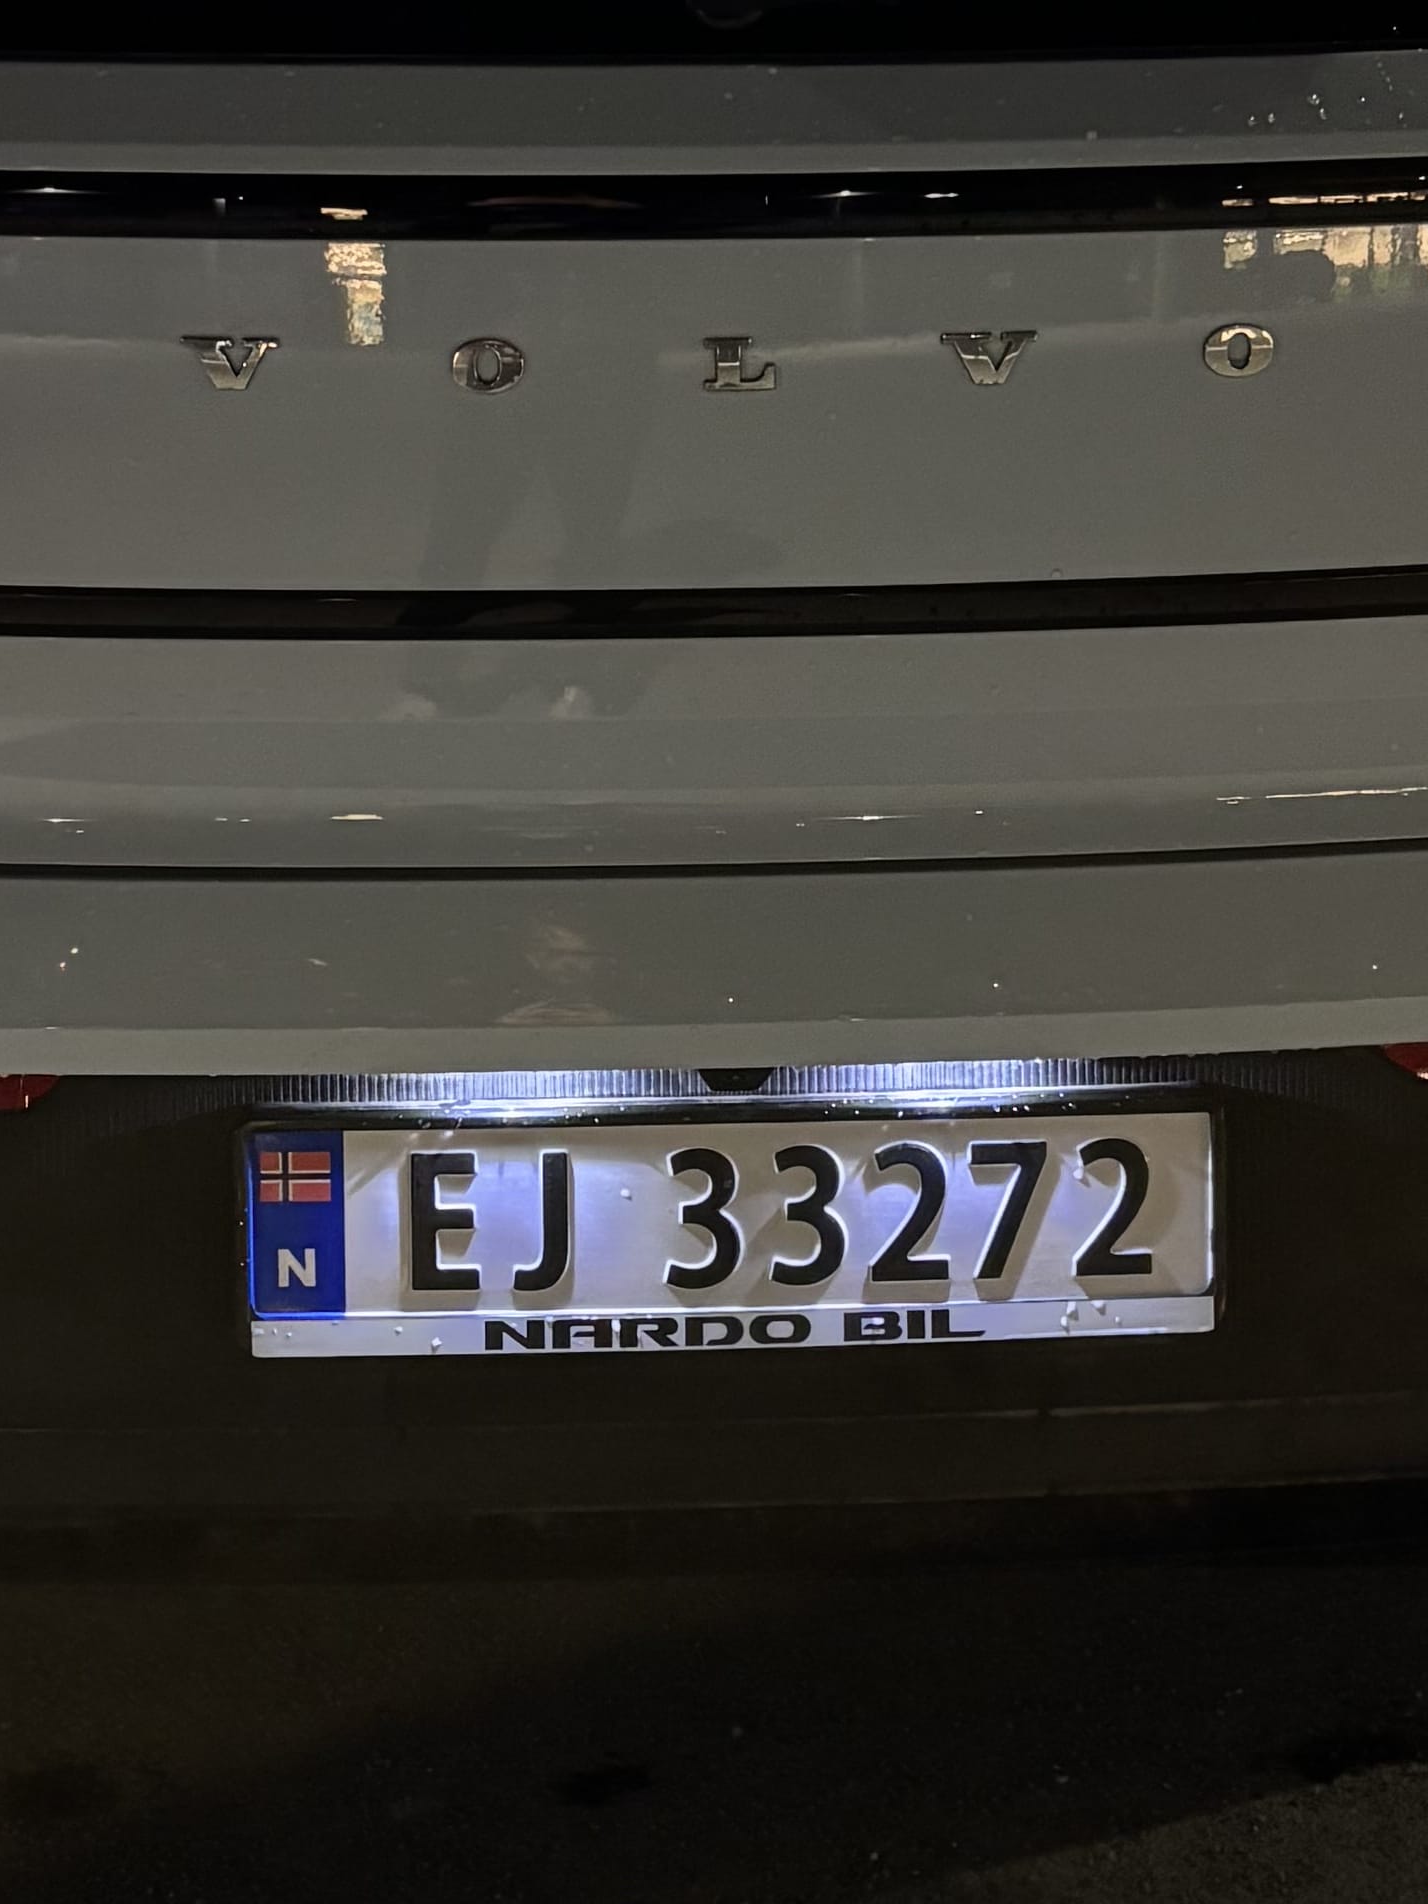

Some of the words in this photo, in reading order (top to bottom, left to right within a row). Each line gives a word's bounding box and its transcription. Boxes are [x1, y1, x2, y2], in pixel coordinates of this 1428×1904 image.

[179, 322, 1275, 394] VOLVO
[410, 1151, 570, 1293] EJ
[663, 1137, 1154, 1291] 33272
[276, 1248, 317, 1288] N
[483, 1310, 811, 1351] NARDO
[841, 1308, 987, 1343] BIL
